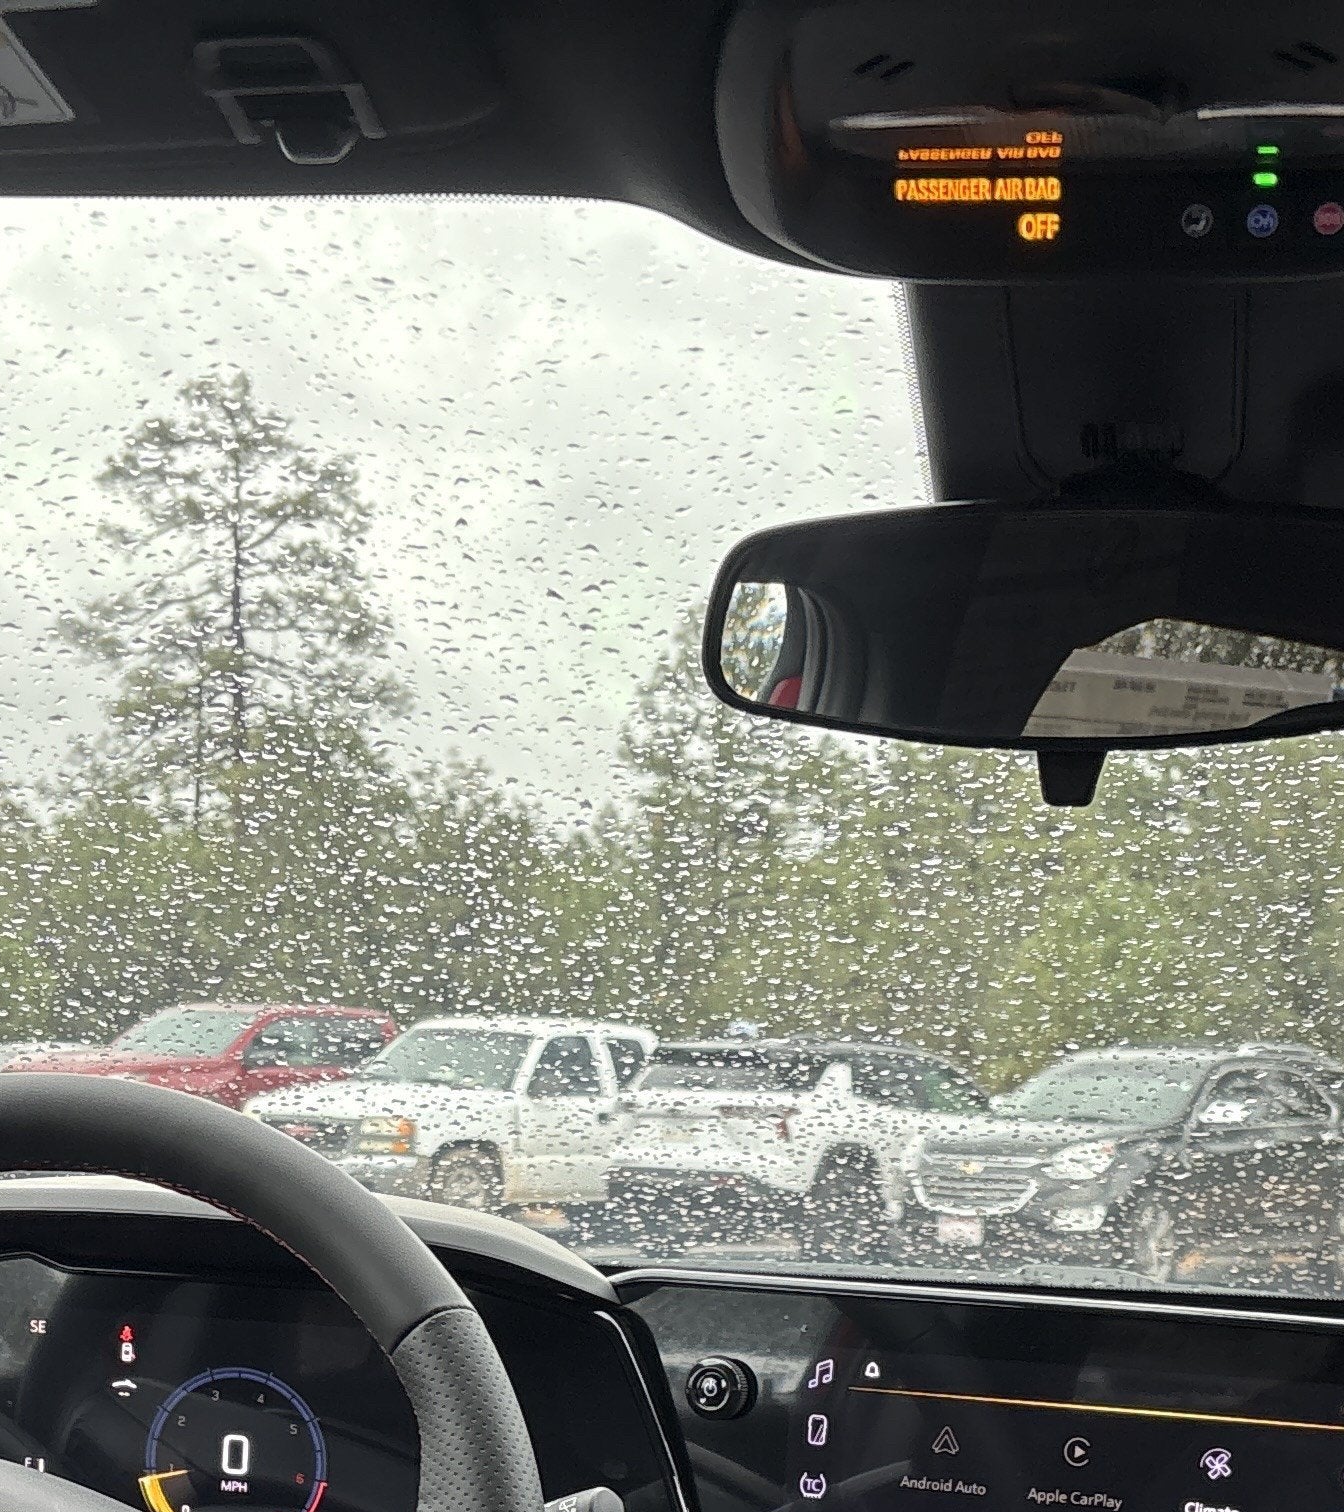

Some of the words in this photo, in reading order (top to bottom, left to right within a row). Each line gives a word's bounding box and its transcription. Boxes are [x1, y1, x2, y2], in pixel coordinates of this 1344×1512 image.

[895, 178, 992, 201] PASSENGER
[994, 177, 1024, 201] AIR
[1025, 176, 1062, 201] BAG
[1018, 213, 1061, 240] OFF
[29, 1319, 47, 1334] SE
[211, 1390, 220, 1401] 3
[257, 1393, 266, 1404] 4
[177, 1415, 186, 1427] 2
[290, 1424, 299, 1435] 5
[222, 1434, 249, 1475] 0
[295, 1472, 305, 1484] 6
[899, 1475, 953, 1493] Android
[955, 1480, 987, 1495] Auto
[220, 1480, 248, 1493] MPH
[1027, 1487, 1068, 1505] Apple
[1070, 1492, 1123, 1512] CarPlay
